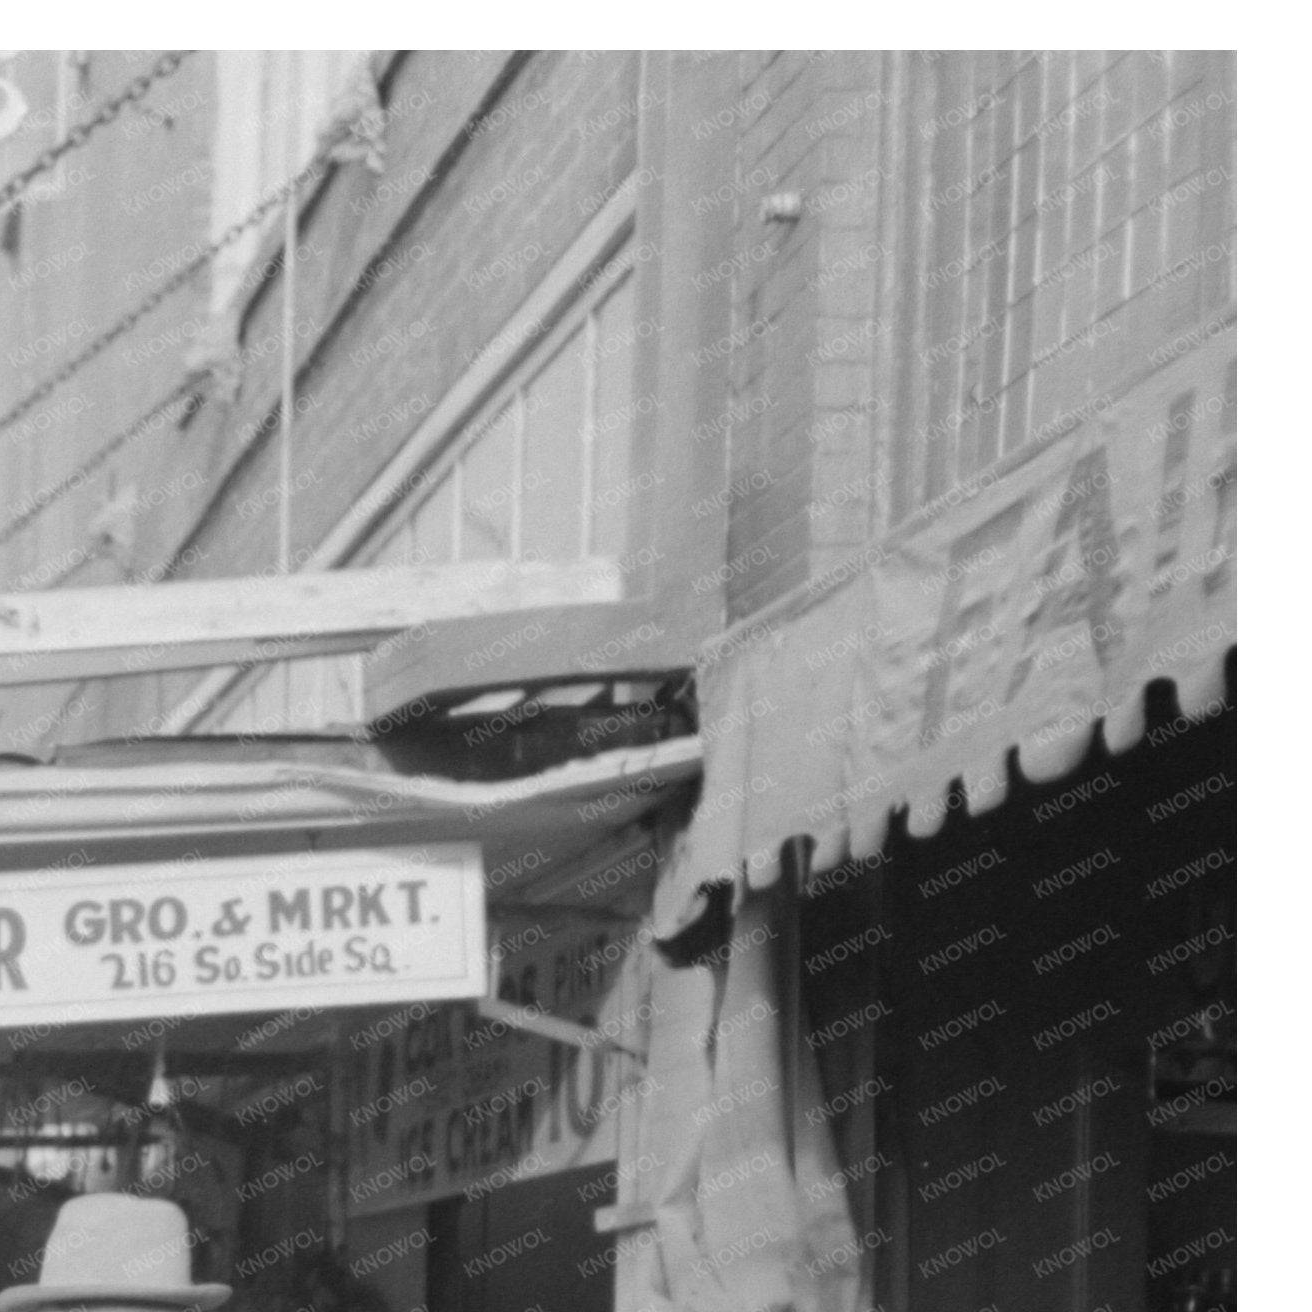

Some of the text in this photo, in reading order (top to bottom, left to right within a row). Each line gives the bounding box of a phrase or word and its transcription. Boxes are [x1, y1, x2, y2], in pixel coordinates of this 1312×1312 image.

[63, 879, 441, 947] GRO. & MRKT.
[100, 948, 177, 990] 216
[194, 944, 249, 986] So.
[254, 938, 334, 982] Side
[445, 1084, 535, 1177] CREAM
